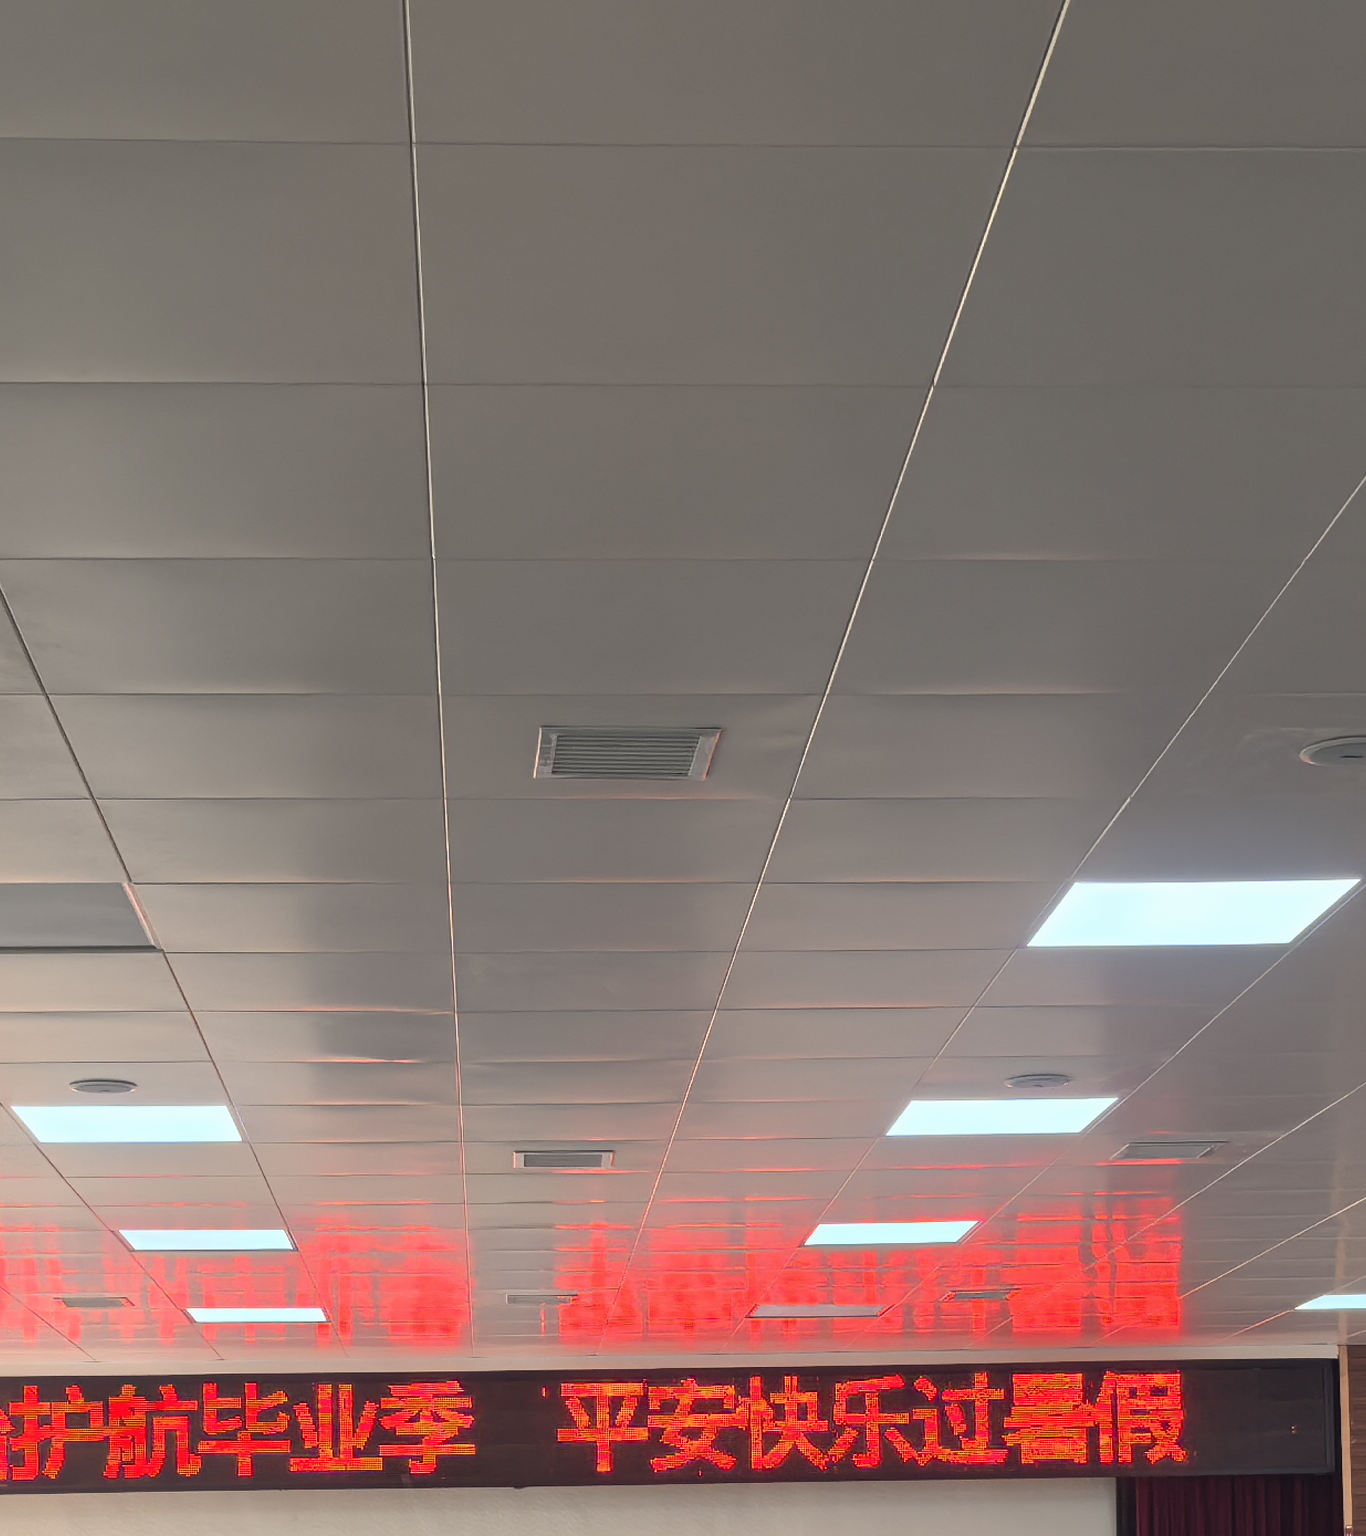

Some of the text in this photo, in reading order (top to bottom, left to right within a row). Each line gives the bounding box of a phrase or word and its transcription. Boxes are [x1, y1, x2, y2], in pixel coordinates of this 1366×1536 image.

[557, 1370, 1187, 1474] 平安快乐过暑假
